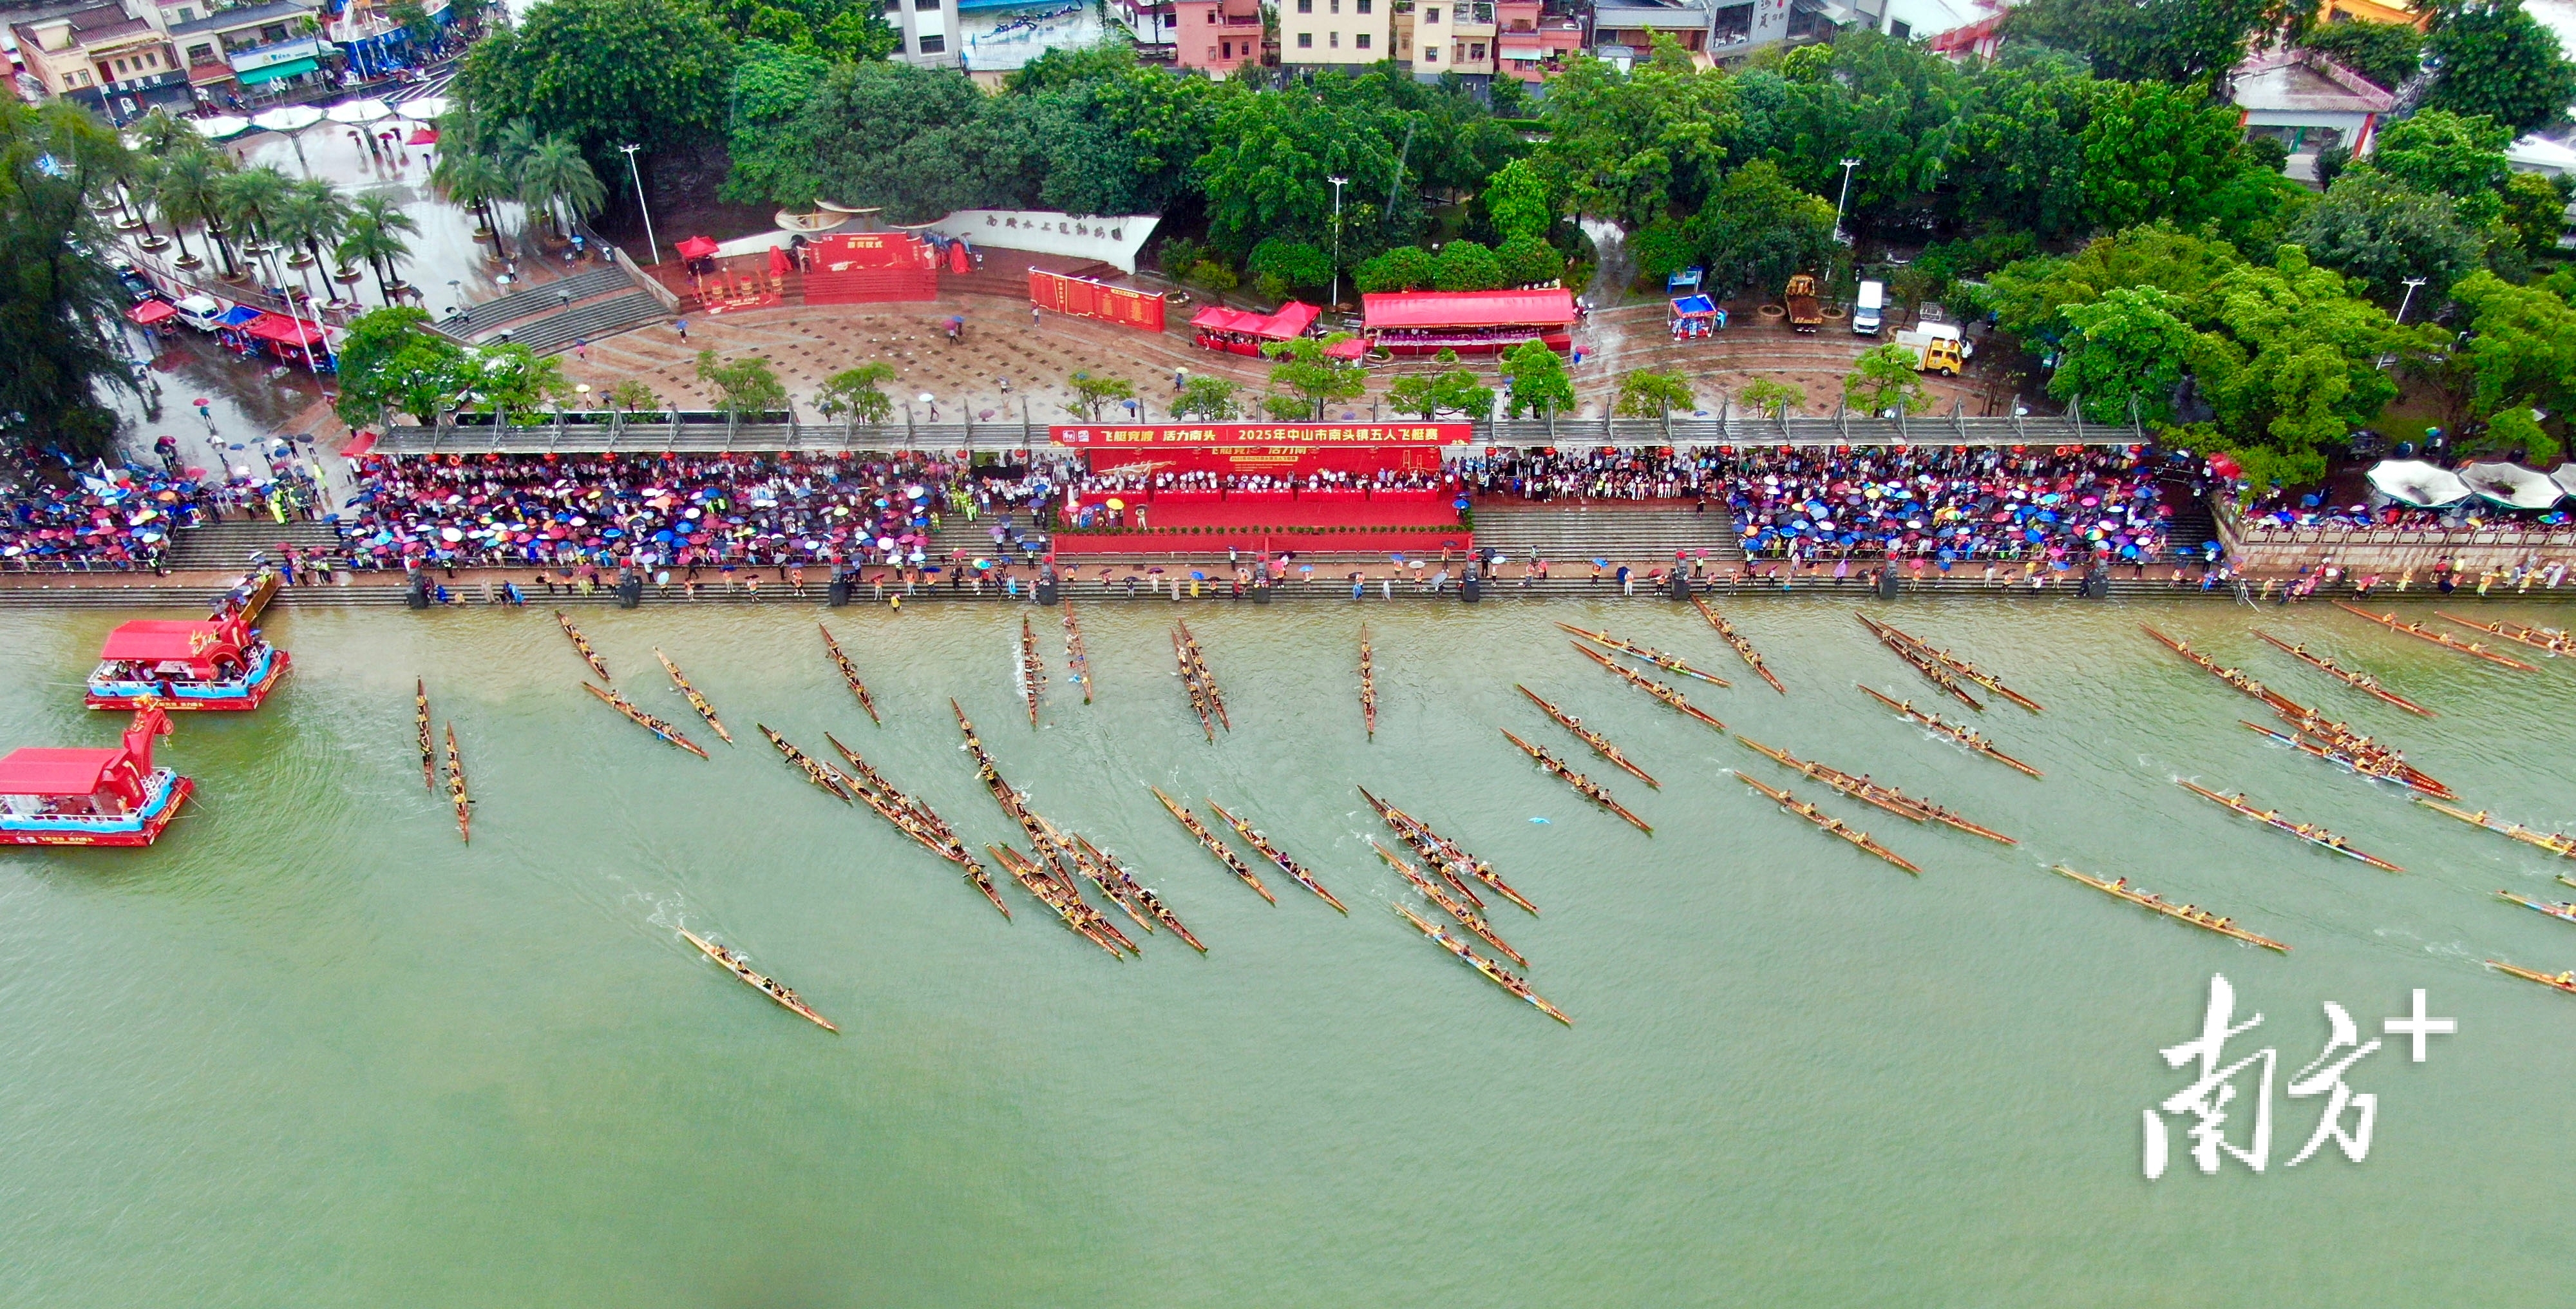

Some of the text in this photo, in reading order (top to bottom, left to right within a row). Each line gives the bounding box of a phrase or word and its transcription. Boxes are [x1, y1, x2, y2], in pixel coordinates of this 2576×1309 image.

[1101, 430, 1153, 442] 飞艇竞渡
[1162, 430, 1216, 442] 活力南头
[1238, 428, 1439, 442] 2025年中山市南头镇五人飞艇赛
